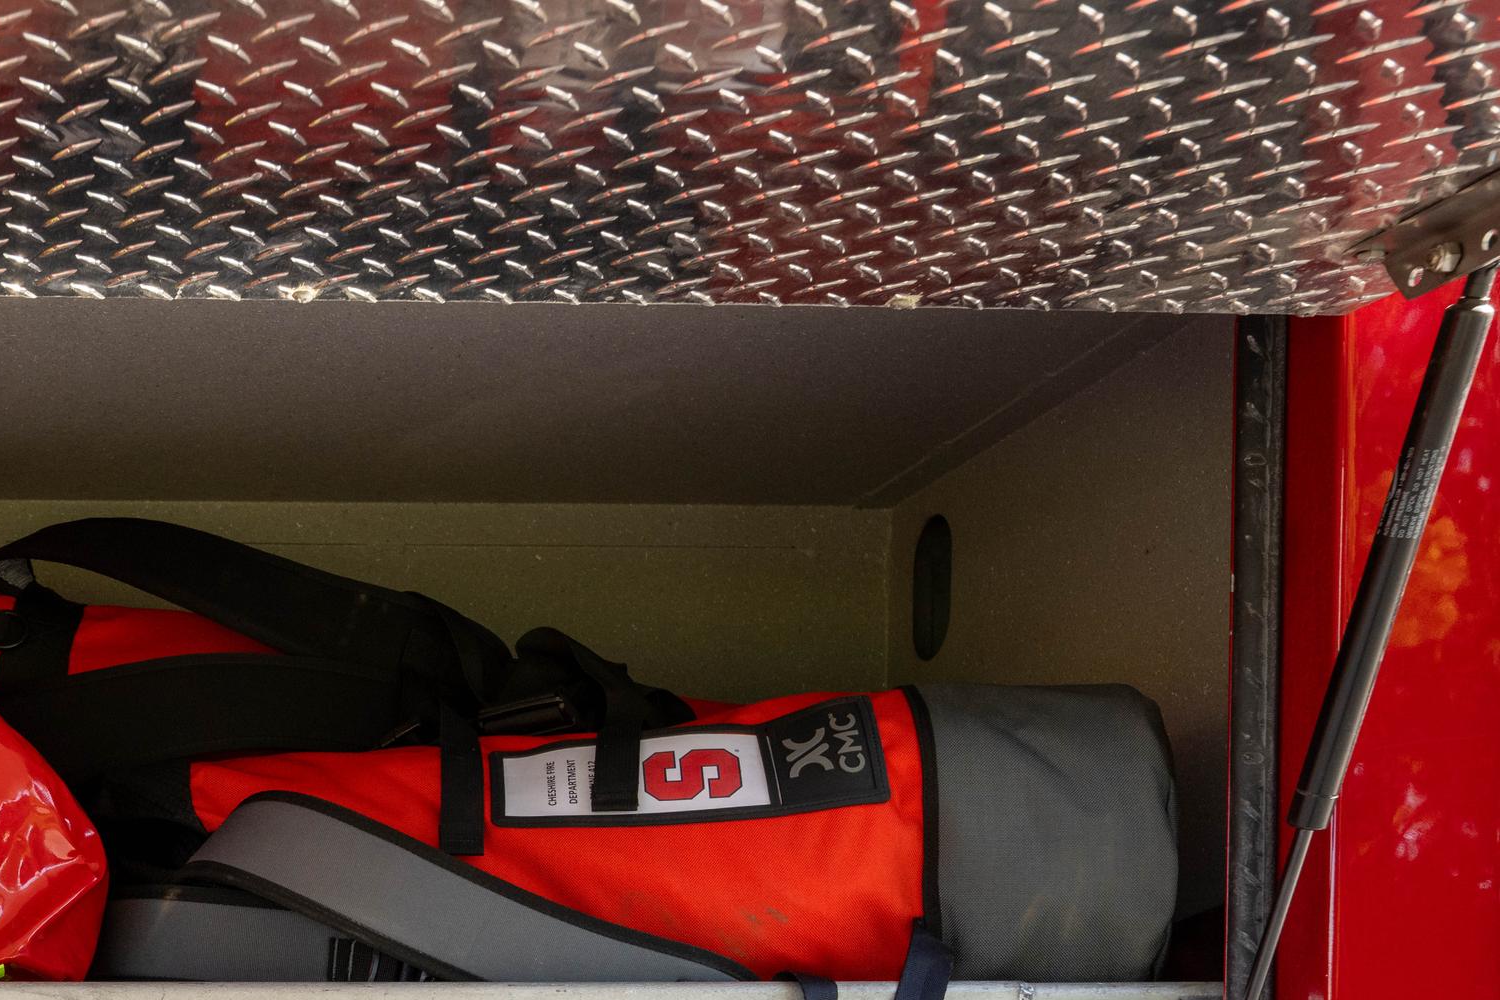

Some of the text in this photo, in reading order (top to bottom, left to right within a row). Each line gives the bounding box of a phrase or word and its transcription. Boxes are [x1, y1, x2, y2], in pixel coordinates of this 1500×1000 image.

[830, 713, 866, 773] CMC
[546, 761, 557, 806] CHESHIRE FIRE
[567, 760, 578, 804] DEPARTMENT
[643, 749, 742, 801] S
